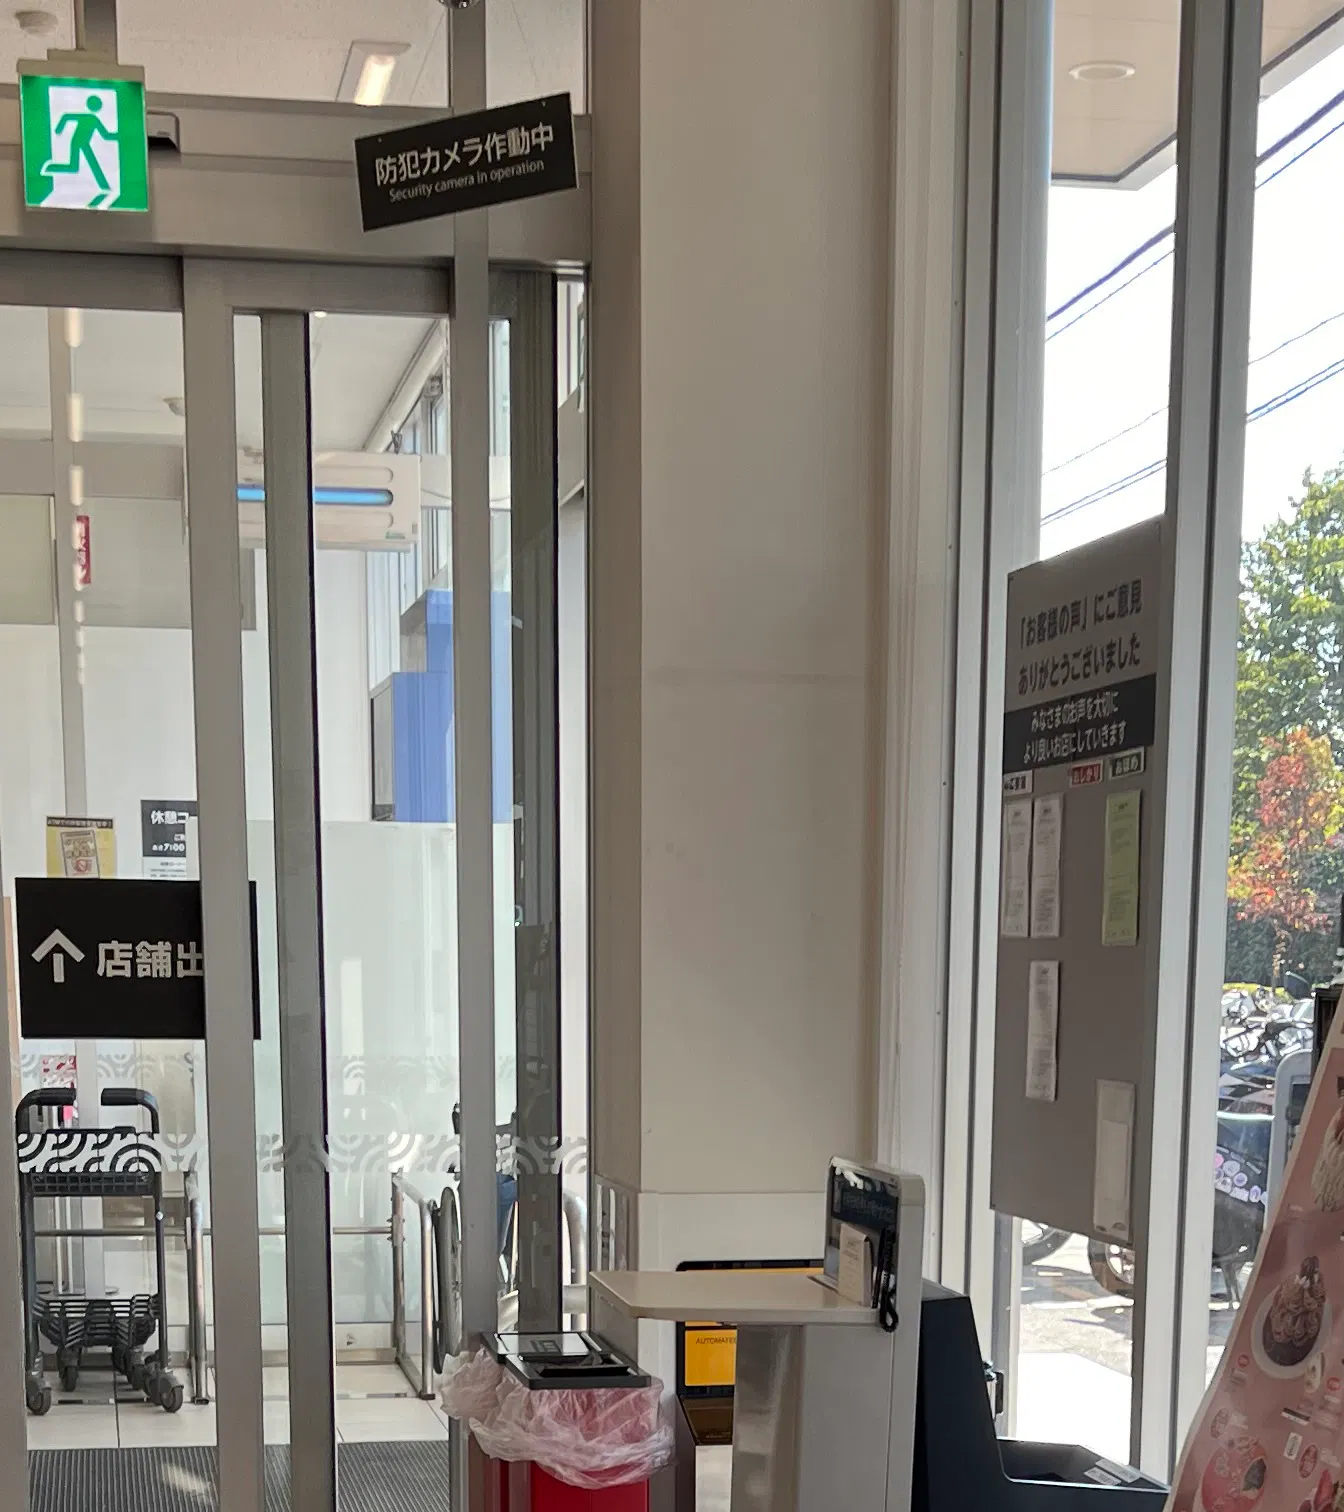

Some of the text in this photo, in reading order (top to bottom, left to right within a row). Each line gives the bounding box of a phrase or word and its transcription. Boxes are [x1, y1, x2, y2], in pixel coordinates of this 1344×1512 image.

[375, 124, 554, 187] 防犯カメラ作動中
[388, 158, 545, 202] Security camera in operation
[1018, 632, 1141, 695] ありがとうございました
